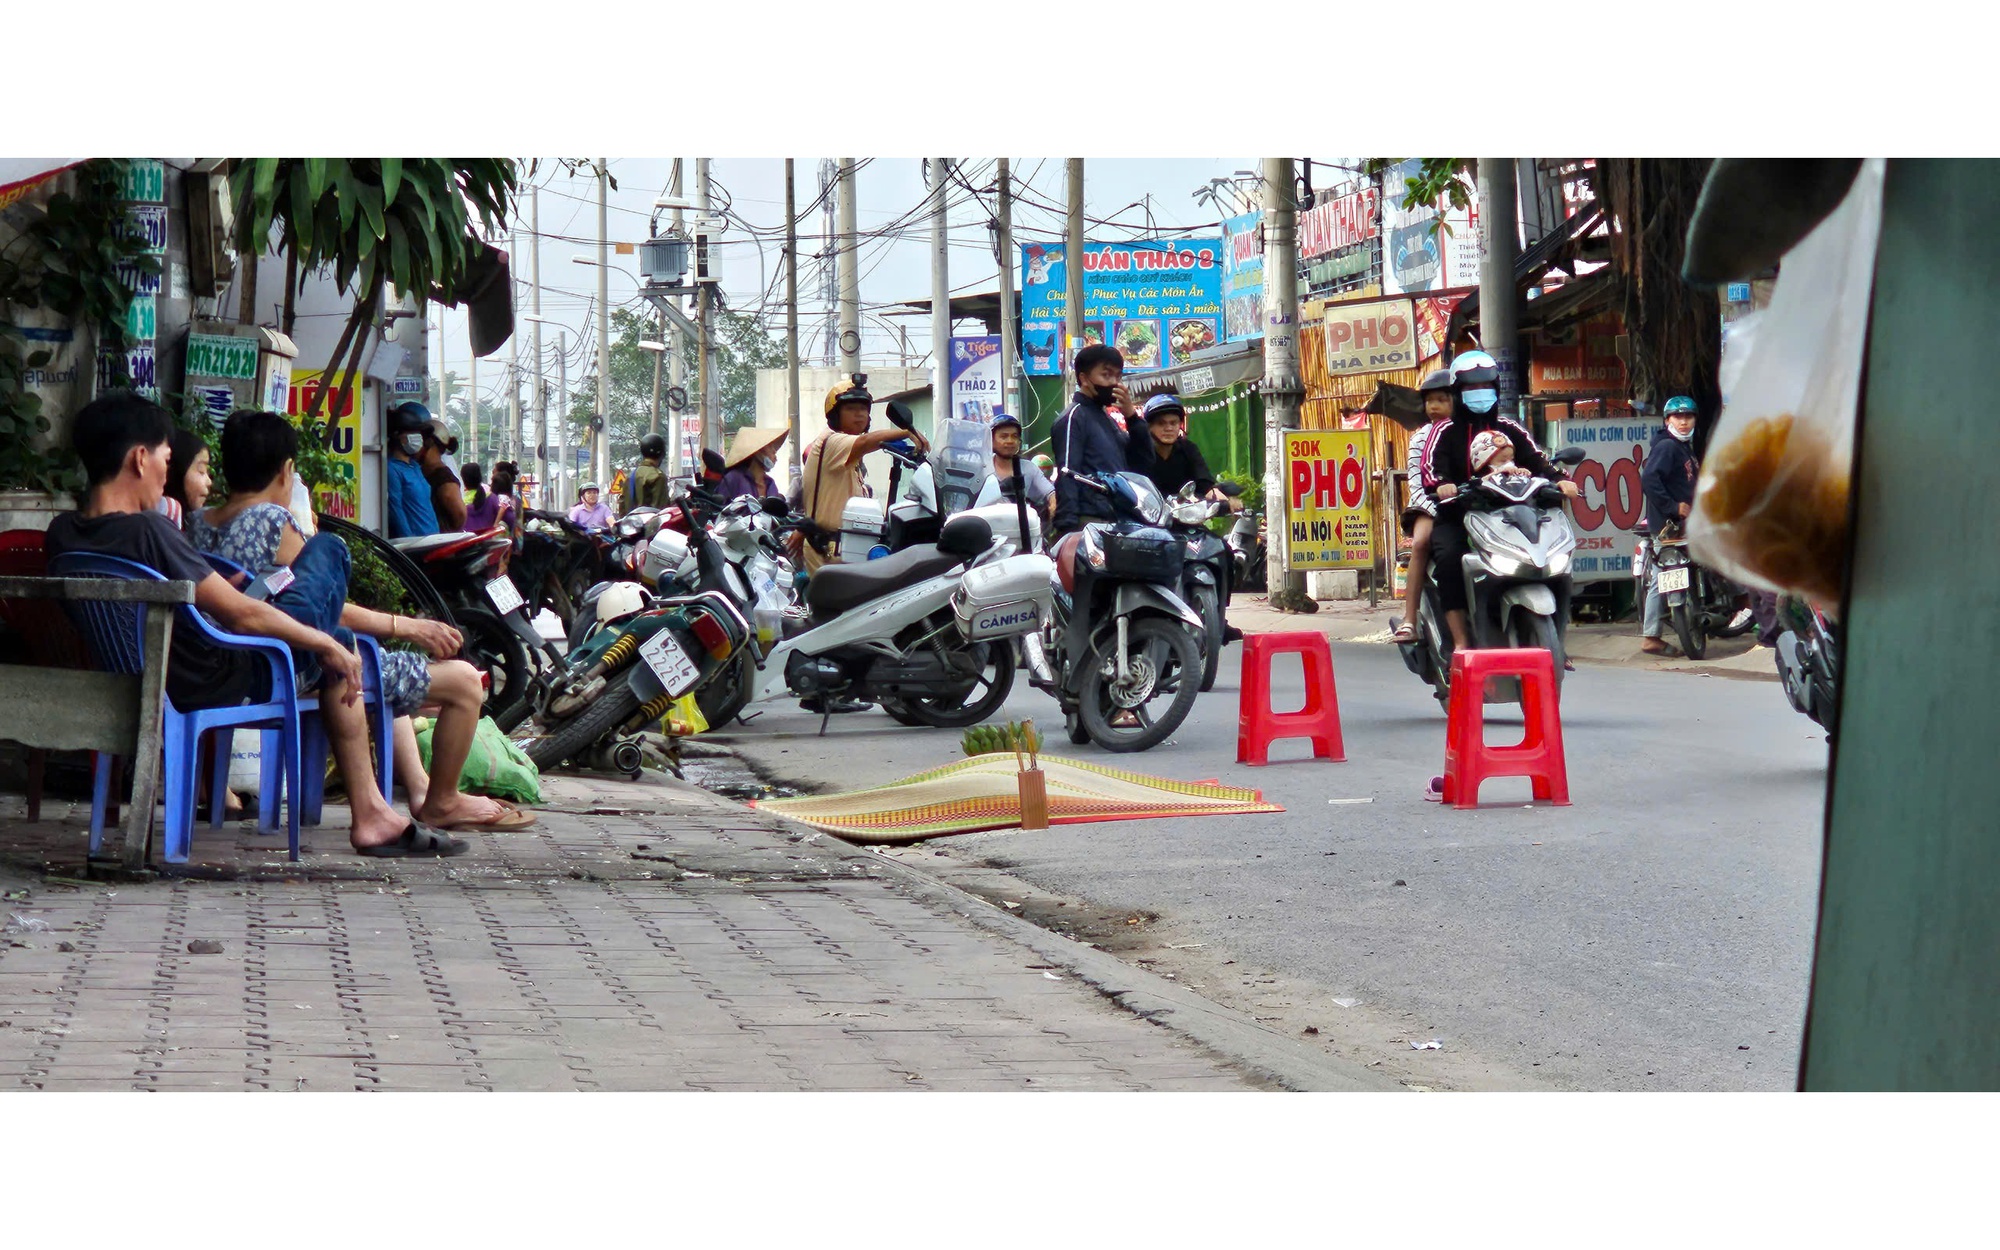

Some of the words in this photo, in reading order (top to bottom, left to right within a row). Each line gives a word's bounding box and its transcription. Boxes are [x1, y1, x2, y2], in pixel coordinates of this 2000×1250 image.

[1367, 190, 1376, 236] 2
[1084, 248, 1129, 270] UÁN
[1134, 243, 1195, 269] THẢO
[1200, 250, 1213, 268] 2
[1092, 289, 1118, 300] Phục
[1122, 288, 1135, 300] Vụ
[1139, 287, 1159, 298] Các
[1161, 287, 1185, 298] Món
[1101, 304, 1127, 317] Sống
[1161, 303, 1180, 314] sản
[1183, 303, 1190, 314] 3
[1194, 302, 1220, 314] miền
[1329, 302, 1408, 353] PHỞ
[967, 341, 998, 356] Tiger
[1332, 355, 1363, 370] HÀ
[1370, 350, 1411, 365] NỘI
[958, 377, 986, 391] THẢO
[989, 379, 997, 391] 2
[288, 380, 354, 417] IÊU
[1567, 425, 1597, 443] QUÁN
[1600, 427, 1624, 442] CƠM
[1627, 425, 1648, 442] QUÊ
[1291, 440, 1321, 457] 30K
[1292, 443, 1366, 509] PHỞ
[1571, 443, 1648, 531] CƠ
[1292, 518, 1308, 542] HÀ
[1311, 517, 1331, 546] NỘI
[1576, 537, 1614, 549] 25K
[1573, 557, 1598, 572] CƠM
[1601, 555, 1632, 572] THÊM
[980, 611, 1019, 630] CẢNH
[1019, 607, 1037, 622] SÁ
[646, 647, 681, 688] 2226
